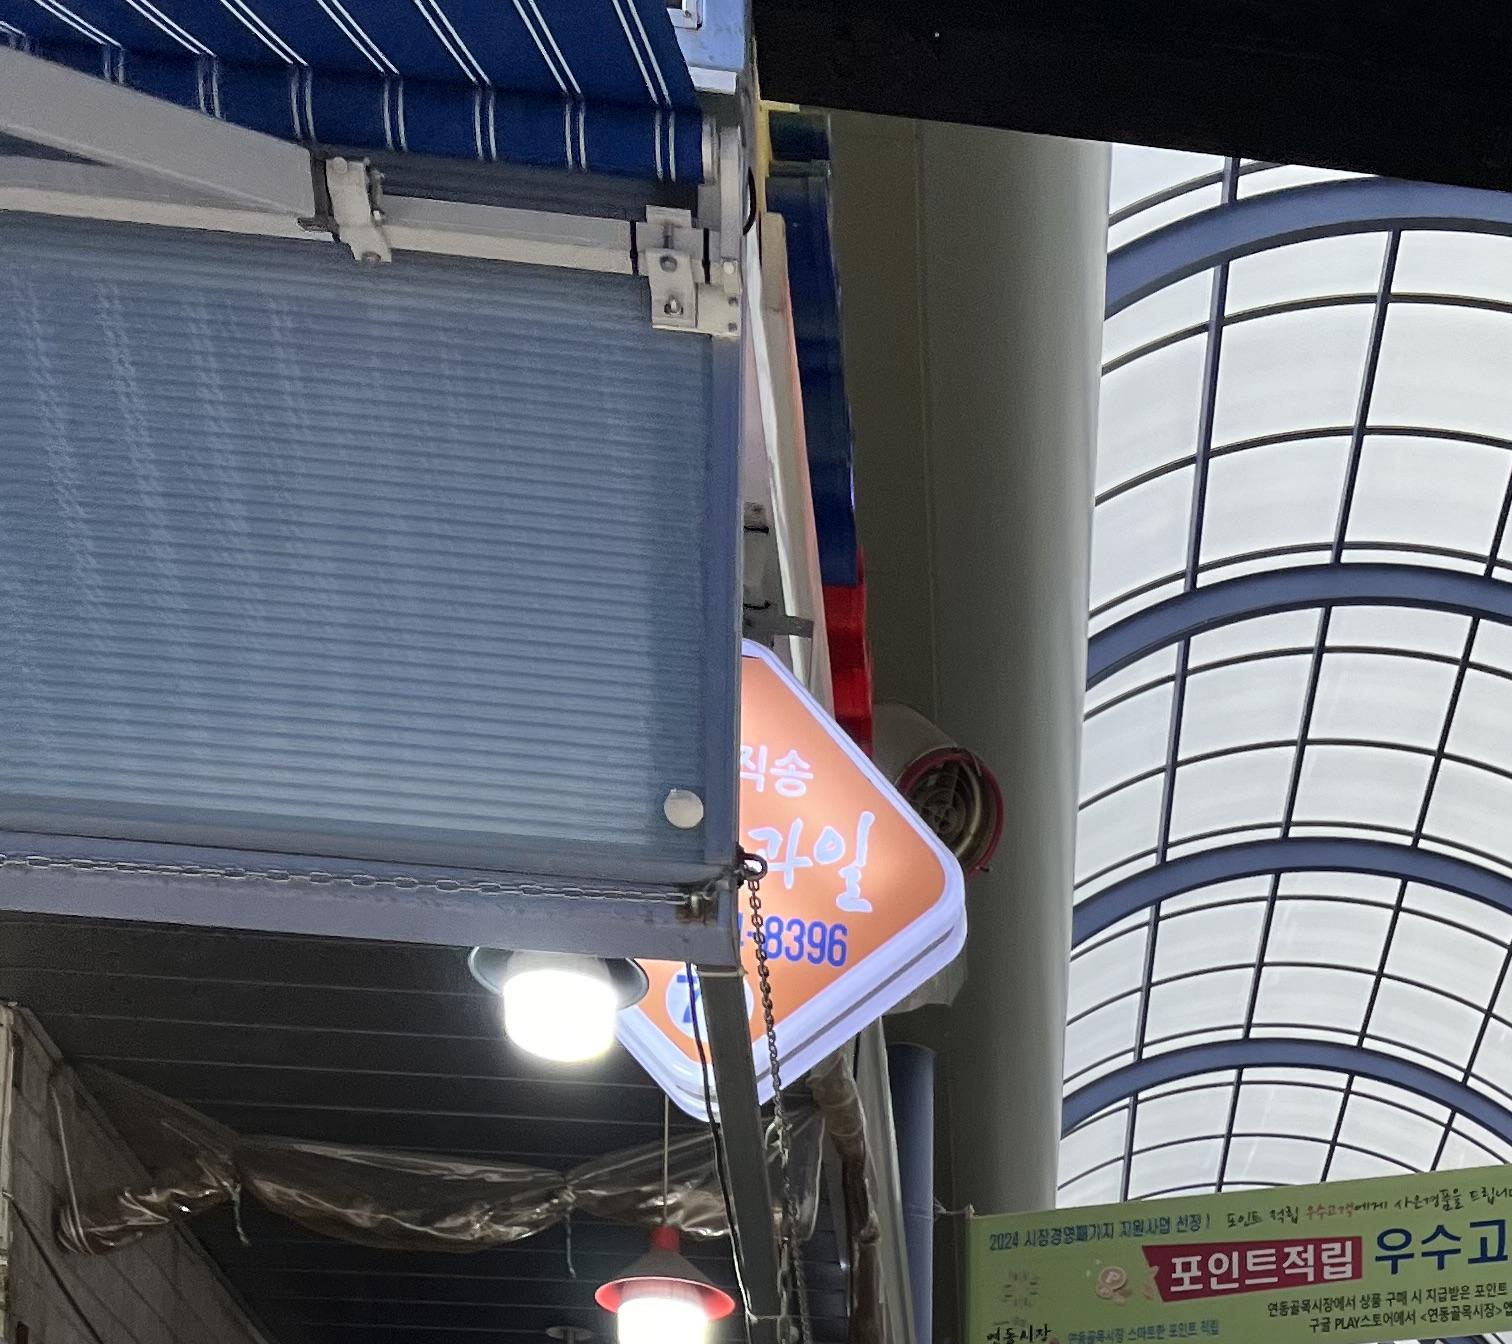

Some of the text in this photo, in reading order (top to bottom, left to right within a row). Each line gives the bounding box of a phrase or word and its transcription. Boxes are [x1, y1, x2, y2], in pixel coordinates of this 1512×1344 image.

[747, 810, 876, 913] 과일
[738, 912, 848, 967] -8396
[1227, 1212, 1262, 1229] 포인트
[1306, 1199, 1388, 1220] 우수고객에게
[1394, 1189, 1463, 1211] 사은경품을
[989, 1234, 1018, 1250] 2024
[1120, 1219, 1171, 1237] 지원사업
[1169, 1239, 1353, 1293] 포인트적립
[1268, 1296, 1356, 1318] 연동골목시장에서
[1359, 1292, 1381, 1309] 상품
[1386, 1290, 1408, 1307] 구매
[1411, 1289, 1423, 1305] 시
[1426, 1284, 1470, 1303] 지급받은
[1474, 1281, 1507, 1299] 포인트
[1168, 1320, 1198, 1339] 포인트
[1309, 1317, 1331, 1333] 구글
[1334, 1311, 1416, 1331] PLAY스토어에서
